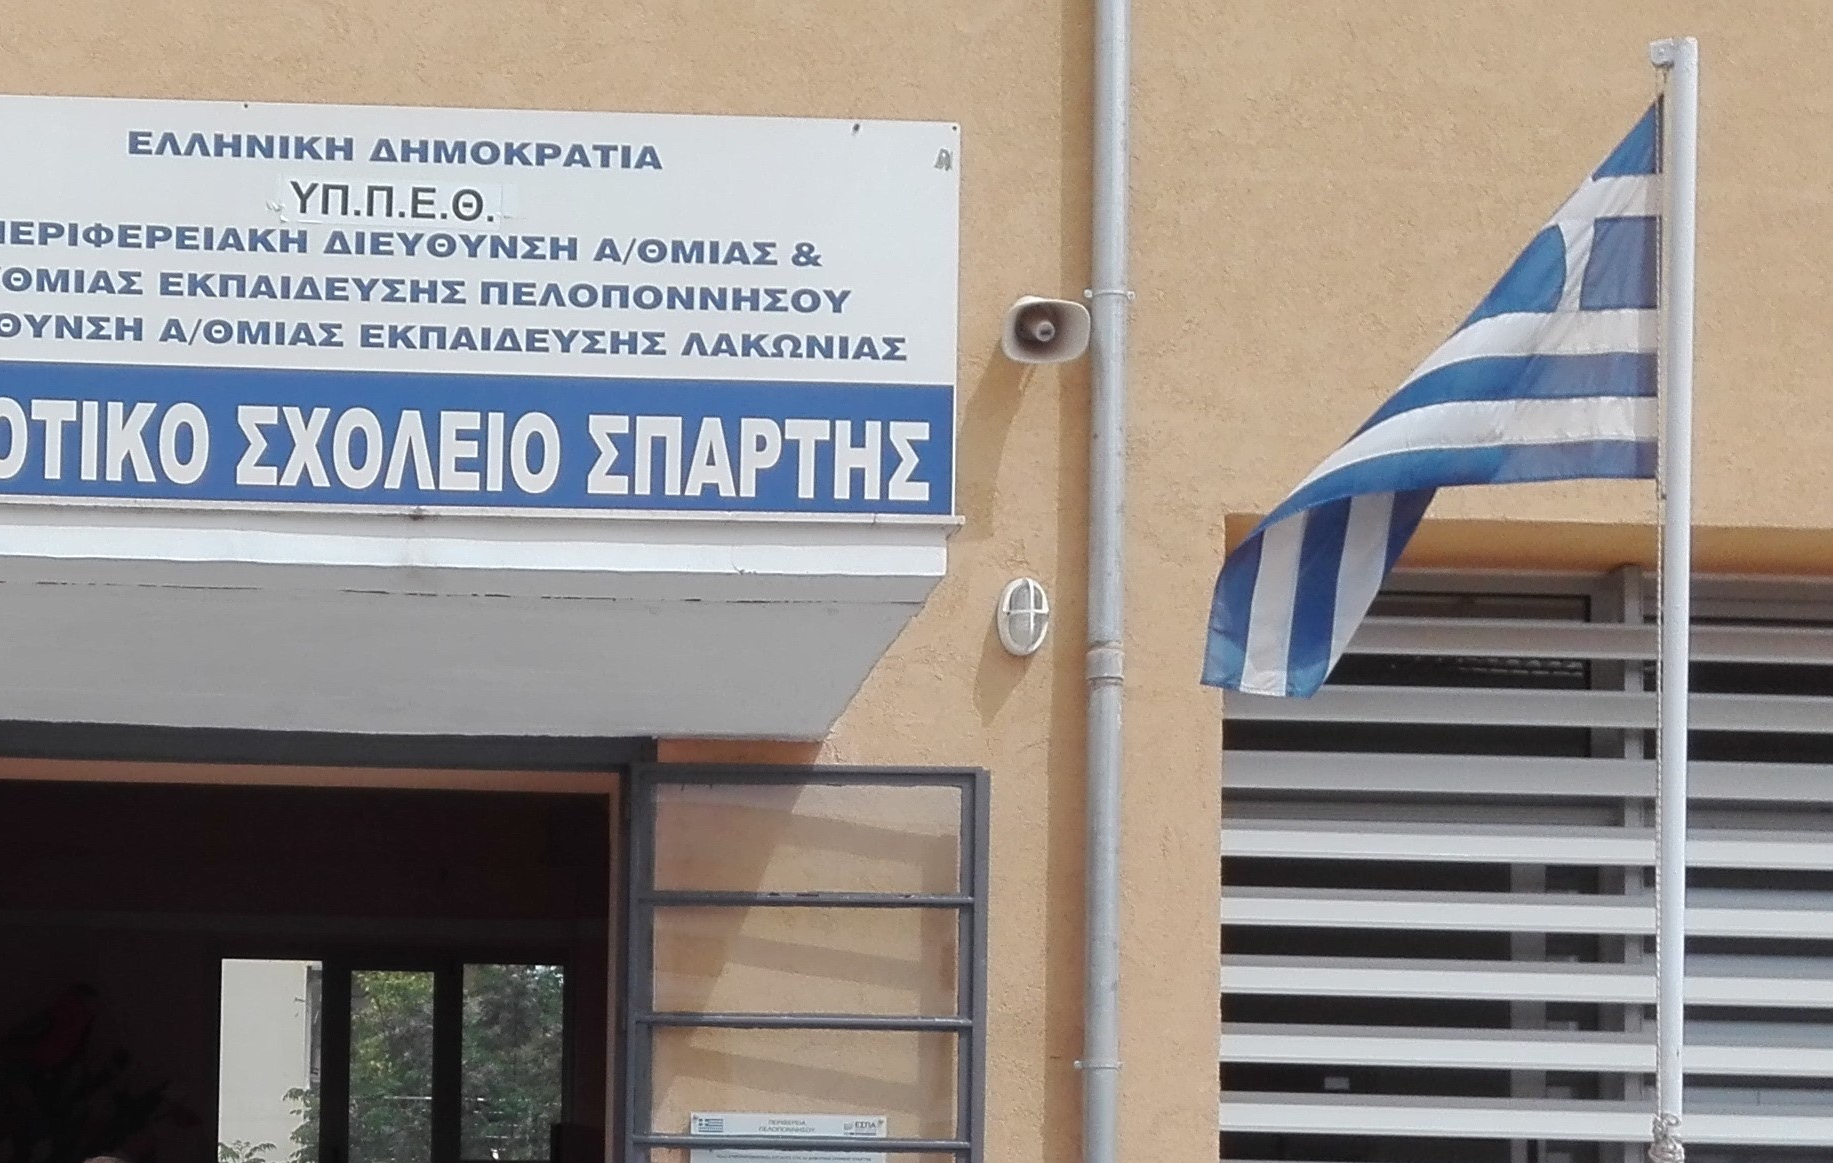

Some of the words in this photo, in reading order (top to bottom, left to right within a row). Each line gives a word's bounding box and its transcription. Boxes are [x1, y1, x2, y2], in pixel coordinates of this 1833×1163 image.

[128, 130, 354, 162] ΕΛΛΗΝΙΚΗ
[369, 136, 664, 170] ΔΗΜΟΚΡΑΤΙΑ
[289, 181, 495, 222] ΥΠ.Π.Ε.Θ.
[323, 231, 578, 262] ΔΙΕΥΘΥΝΣΗ
[594, 237, 778, 267] Α/ΘΜΙΑΣ
[791, 242, 823, 268] &
[159, 271, 466, 304] ΕΚΠΑΙΔΕΥΣΗΣ
[480, 281, 851, 314] ΠΕΛΟΠΟΝΝΗΣΟΥ
[159, 317, 343, 348] Α/ΘΜΙΑΣ
[359, 323, 667, 357] ΕΚΠΑΙΔΕΥΣΗΣ
[681, 333, 908, 362] ΛΑΚΩΝΙΑΣ
[236, 405, 561, 494] ΣΧΟΛΕΙΟ
[586, 414, 930, 501] ΣΠΑΡΤΗΣ
